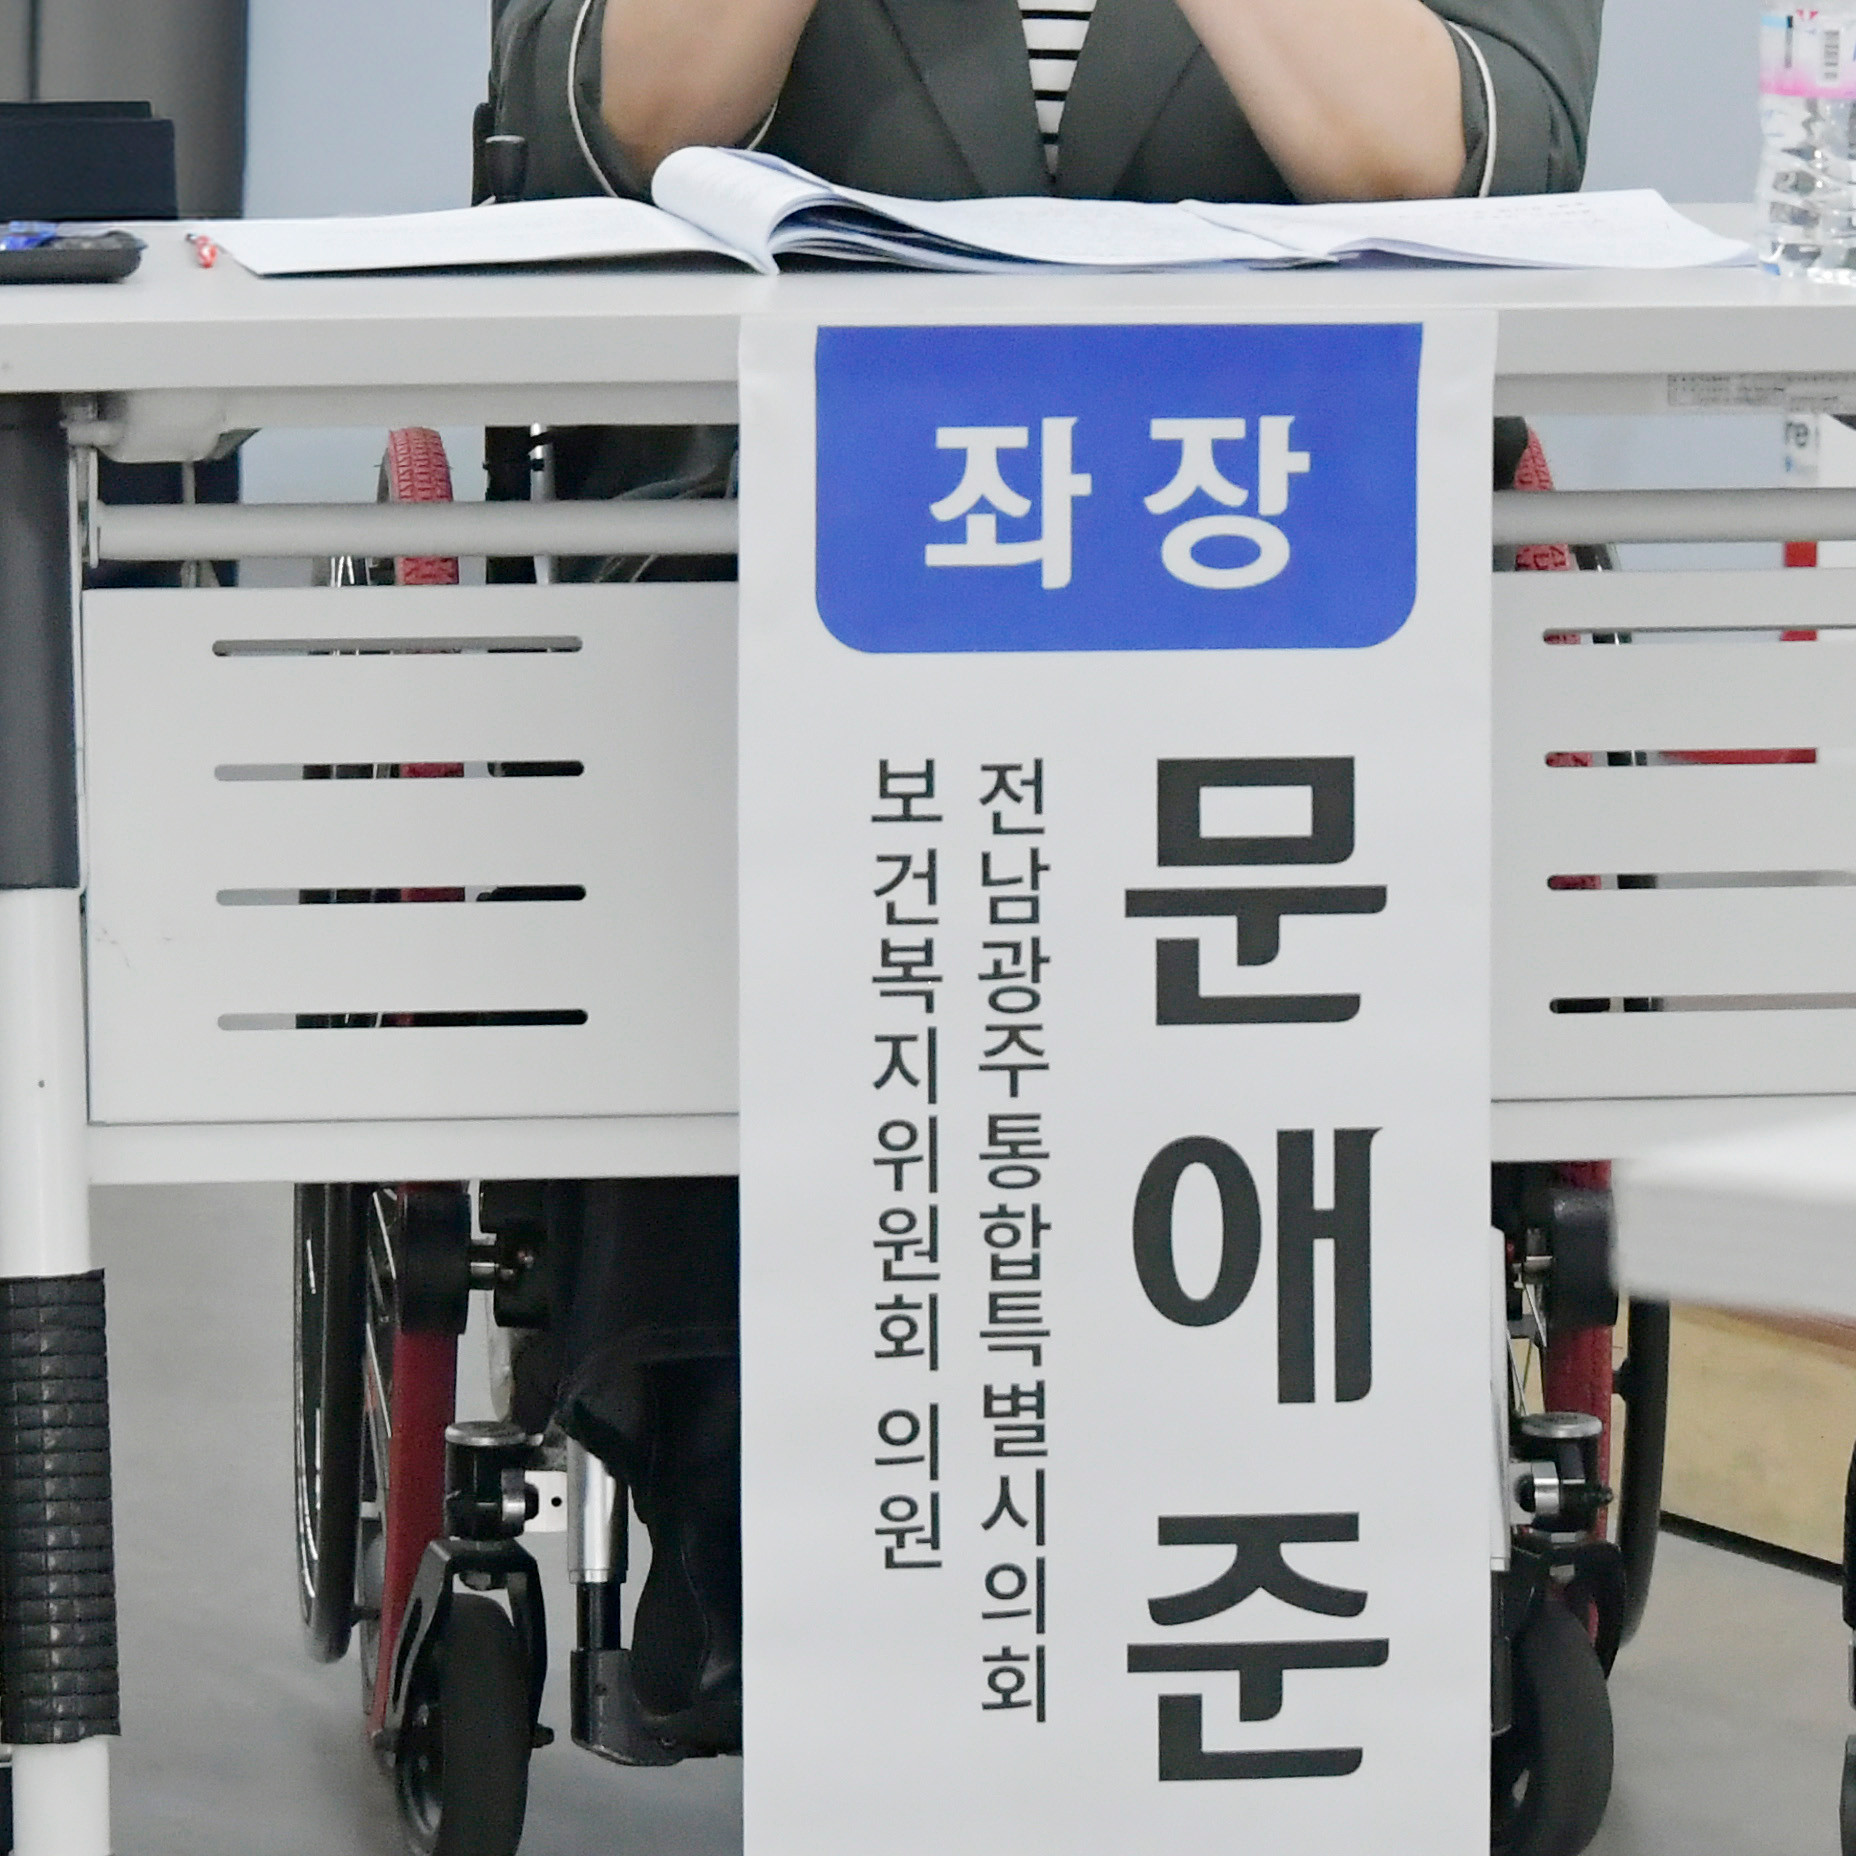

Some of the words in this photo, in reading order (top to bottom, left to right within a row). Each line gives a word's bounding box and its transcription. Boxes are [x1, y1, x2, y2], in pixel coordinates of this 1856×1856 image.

[924, 415, 1311, 590] 좌장
[871, 758, 943, 1372] 보건복지위원회
[978, 758, 1052, 1723] 전남광주통합특별시의회
[1124, 756, 1390, 1782] 문애준
[874, 1403, 942, 1570] 의원
